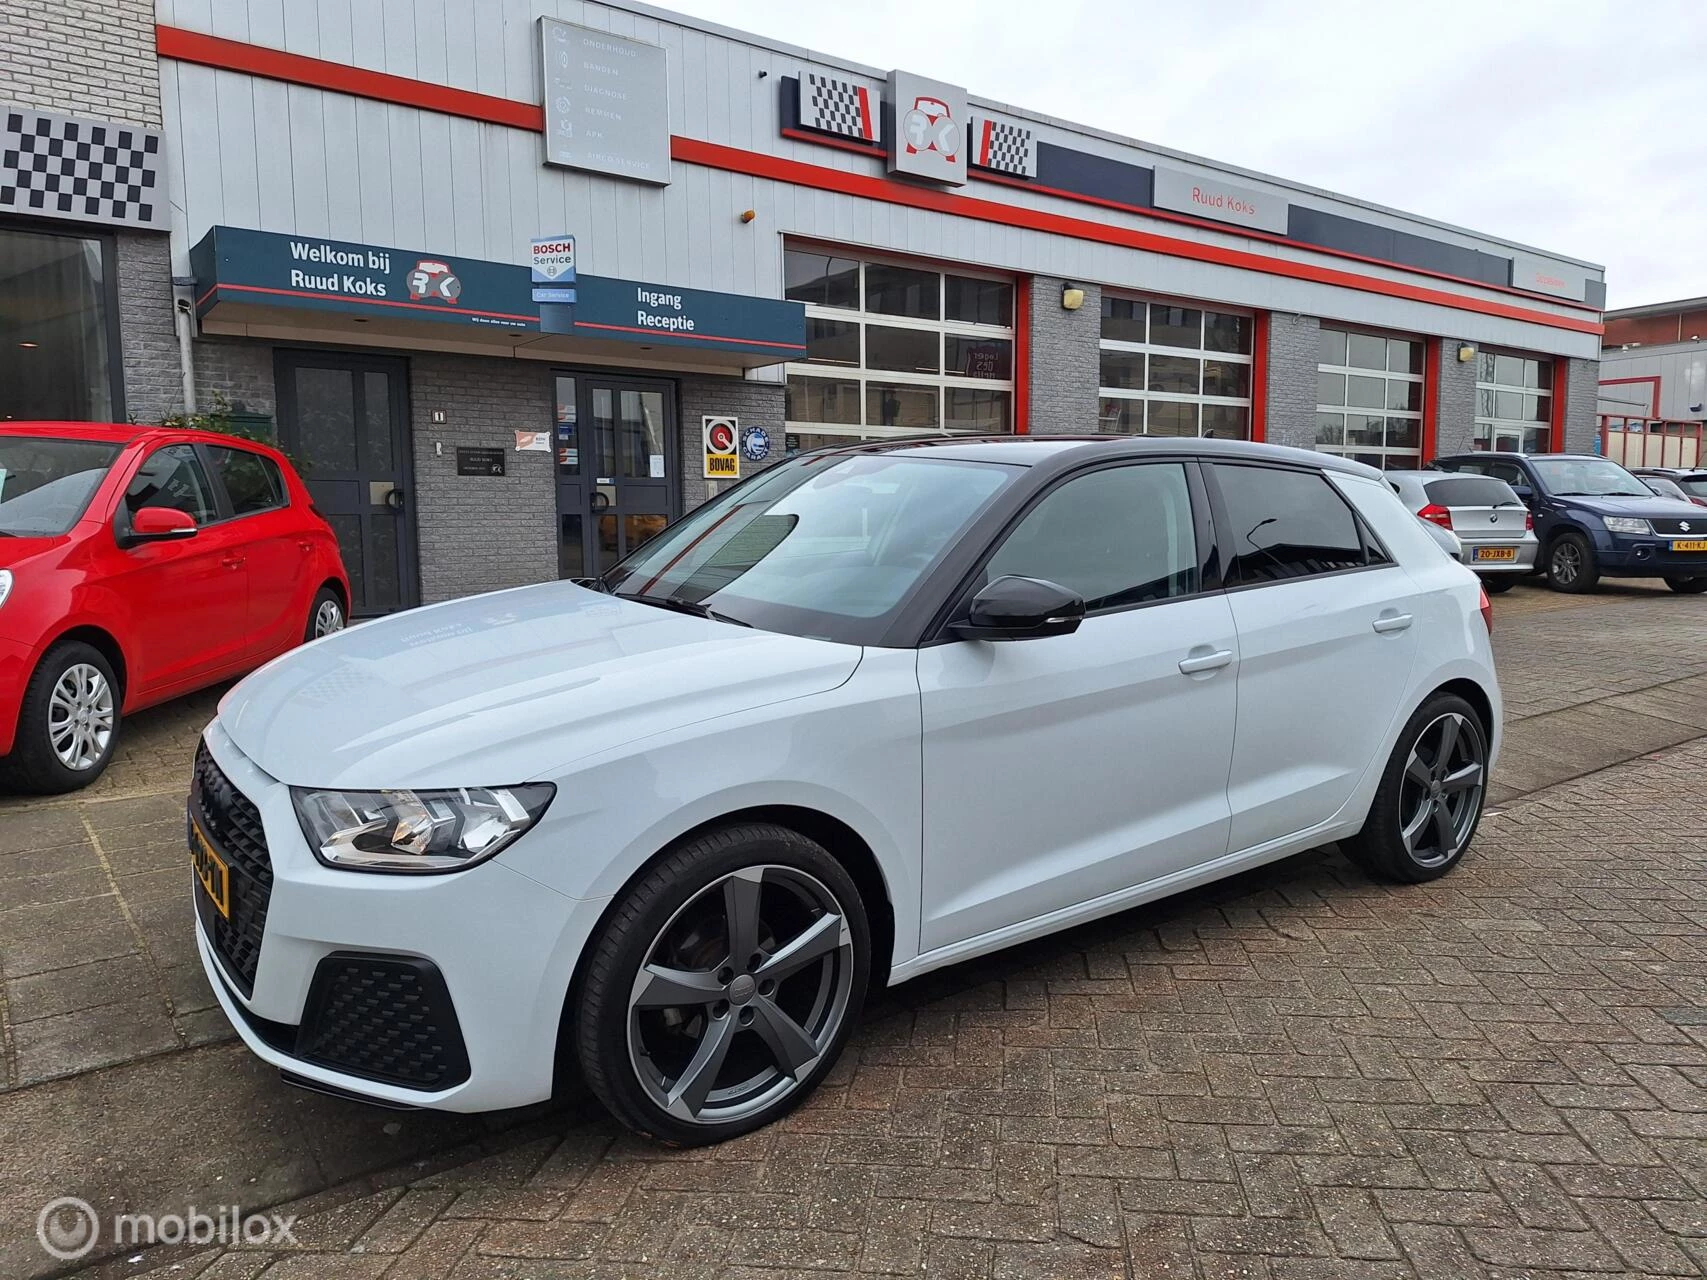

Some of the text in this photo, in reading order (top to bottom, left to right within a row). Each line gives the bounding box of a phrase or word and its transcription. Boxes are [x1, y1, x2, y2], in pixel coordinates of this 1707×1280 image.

[1192, 187, 1256, 215] Ruud Koks
[290, 241, 390, 274] Welkom bij
[533, 242, 571, 255] BOSCH
[533, 255, 572, 266] Service
[291, 269, 387, 297] Ruud Koks
[637, 287, 682, 310] Ingang
[637, 311, 695, 332] Receptie
[709, 457, 735, 472] BOVAG
